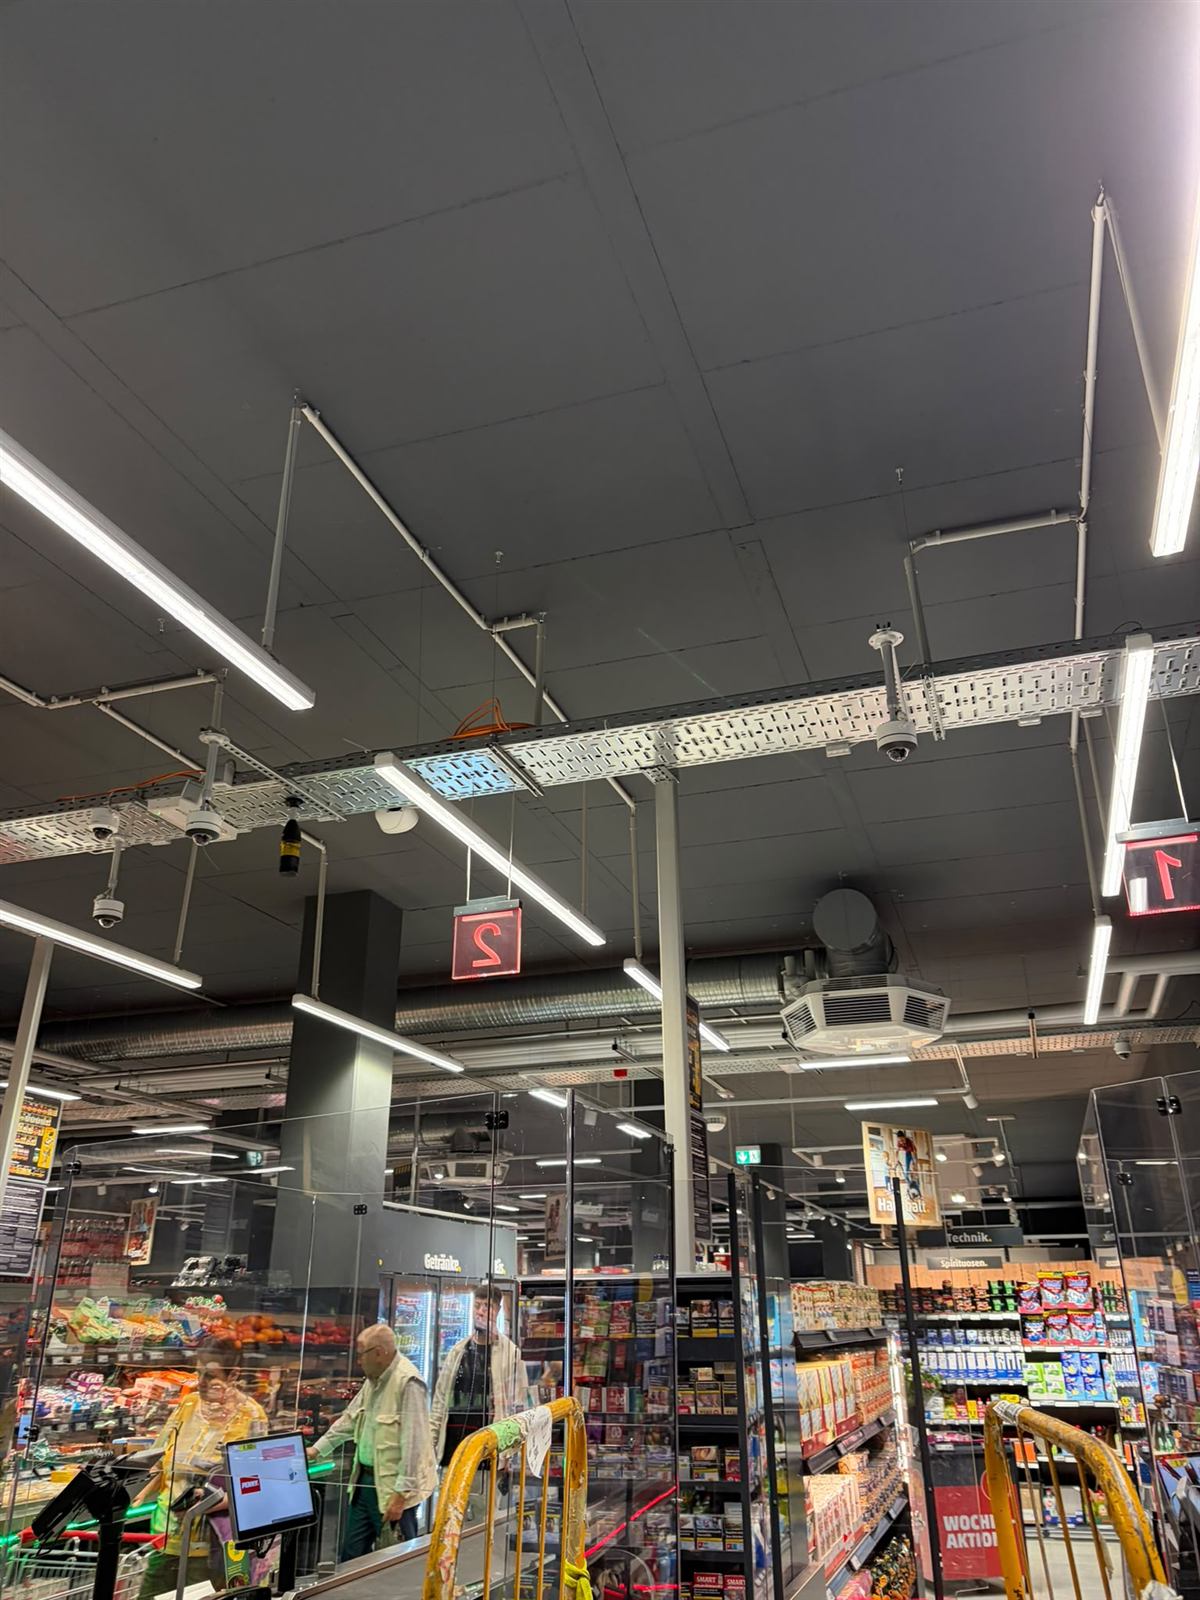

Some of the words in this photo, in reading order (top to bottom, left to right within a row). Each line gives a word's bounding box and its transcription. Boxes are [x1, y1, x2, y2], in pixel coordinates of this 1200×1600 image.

[946, 1231, 993, 1243] Technik.
[424, 1252, 462, 1273] Getränke.
[940, 1258, 988, 1268] Spirituosen.
